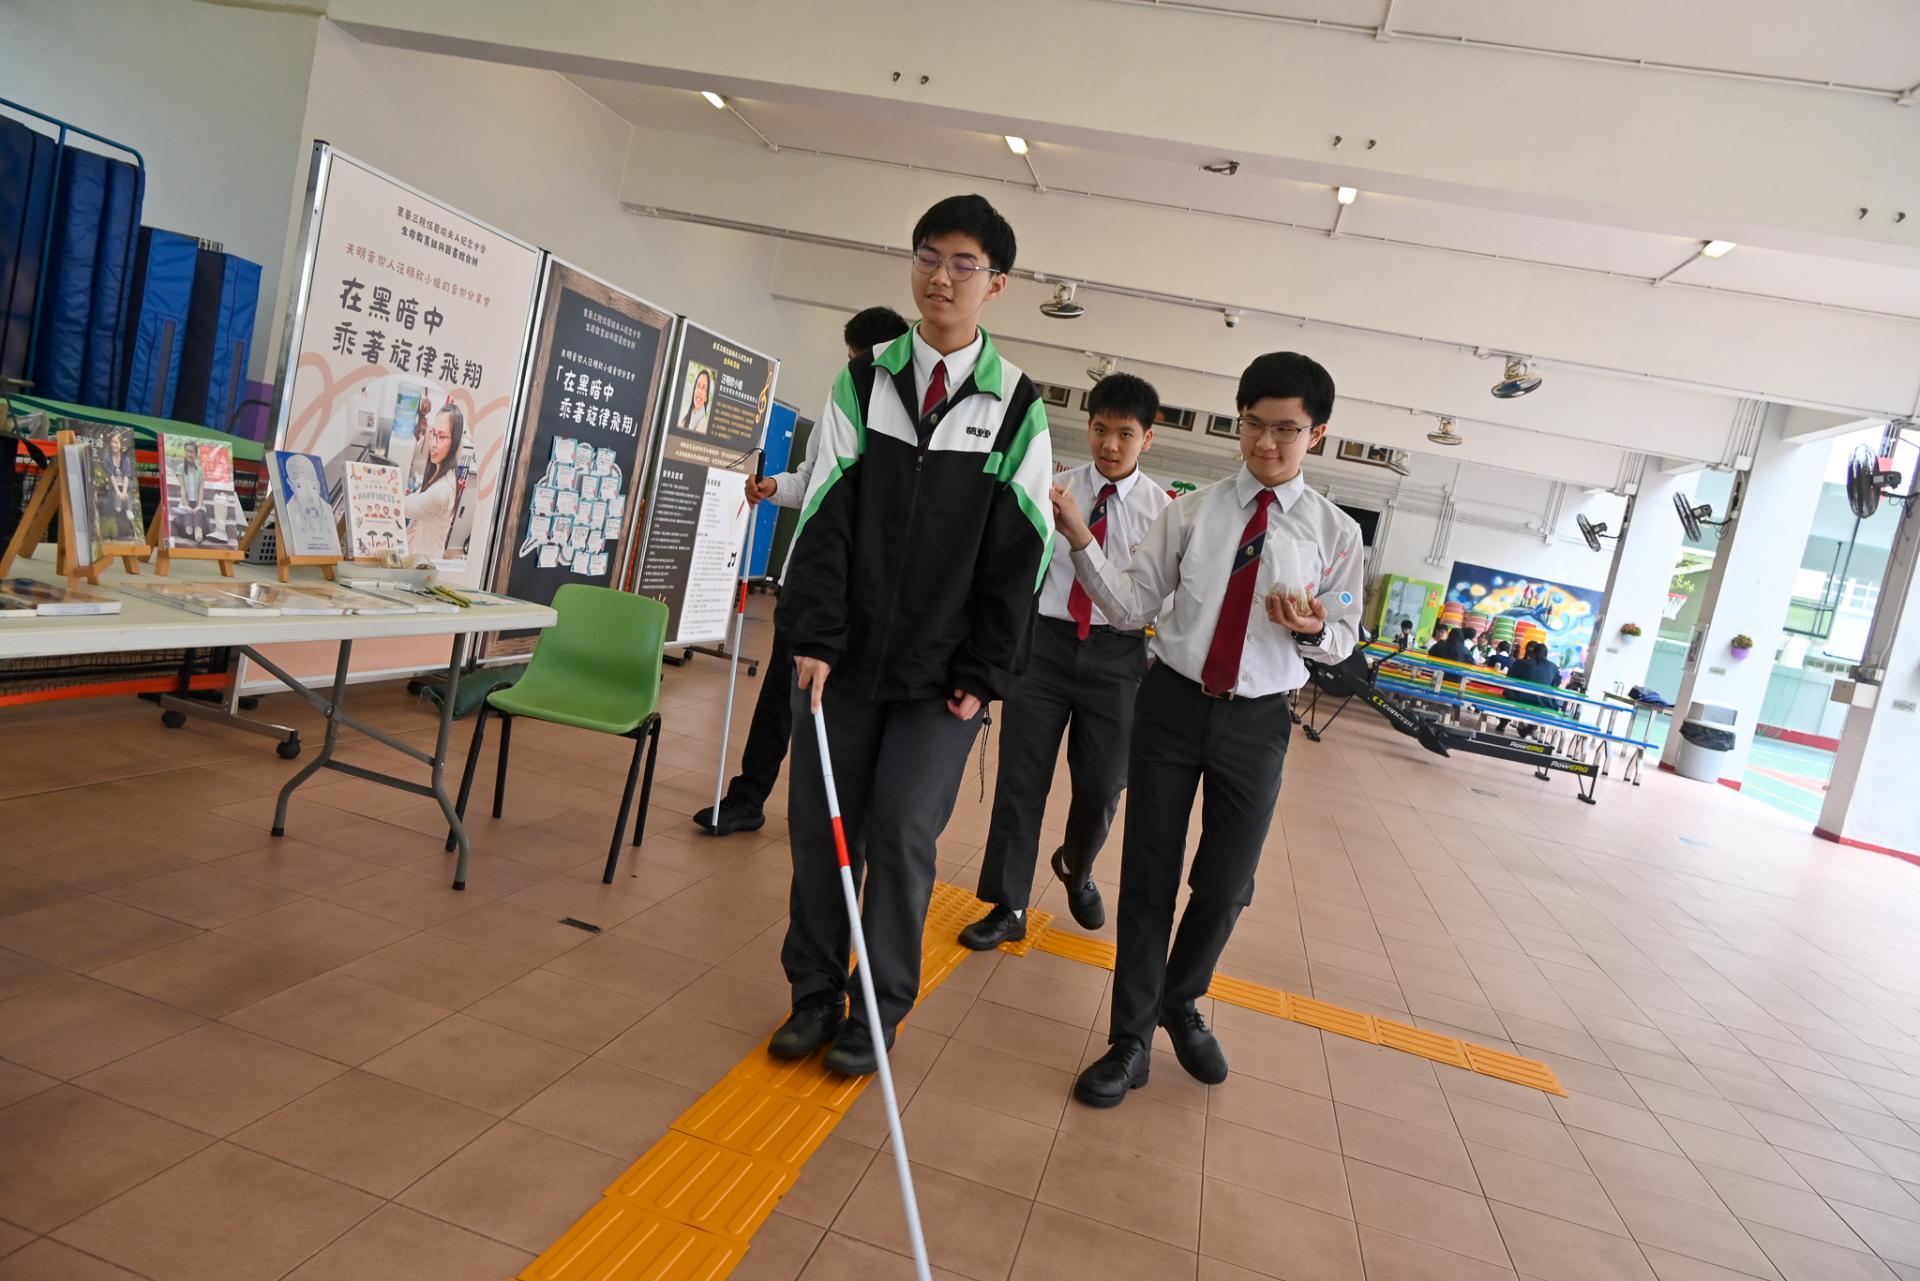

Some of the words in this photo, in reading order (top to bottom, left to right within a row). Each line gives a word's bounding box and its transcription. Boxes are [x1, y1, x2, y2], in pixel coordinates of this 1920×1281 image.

[339, 276, 444, 336] 在黑暗中
[332, 321, 483, 390] 乘著旋律飛翔
[556, 365, 615, 403] 「在黑暗中
[559, 397, 638, 437] 乘著旋律飛翔」
